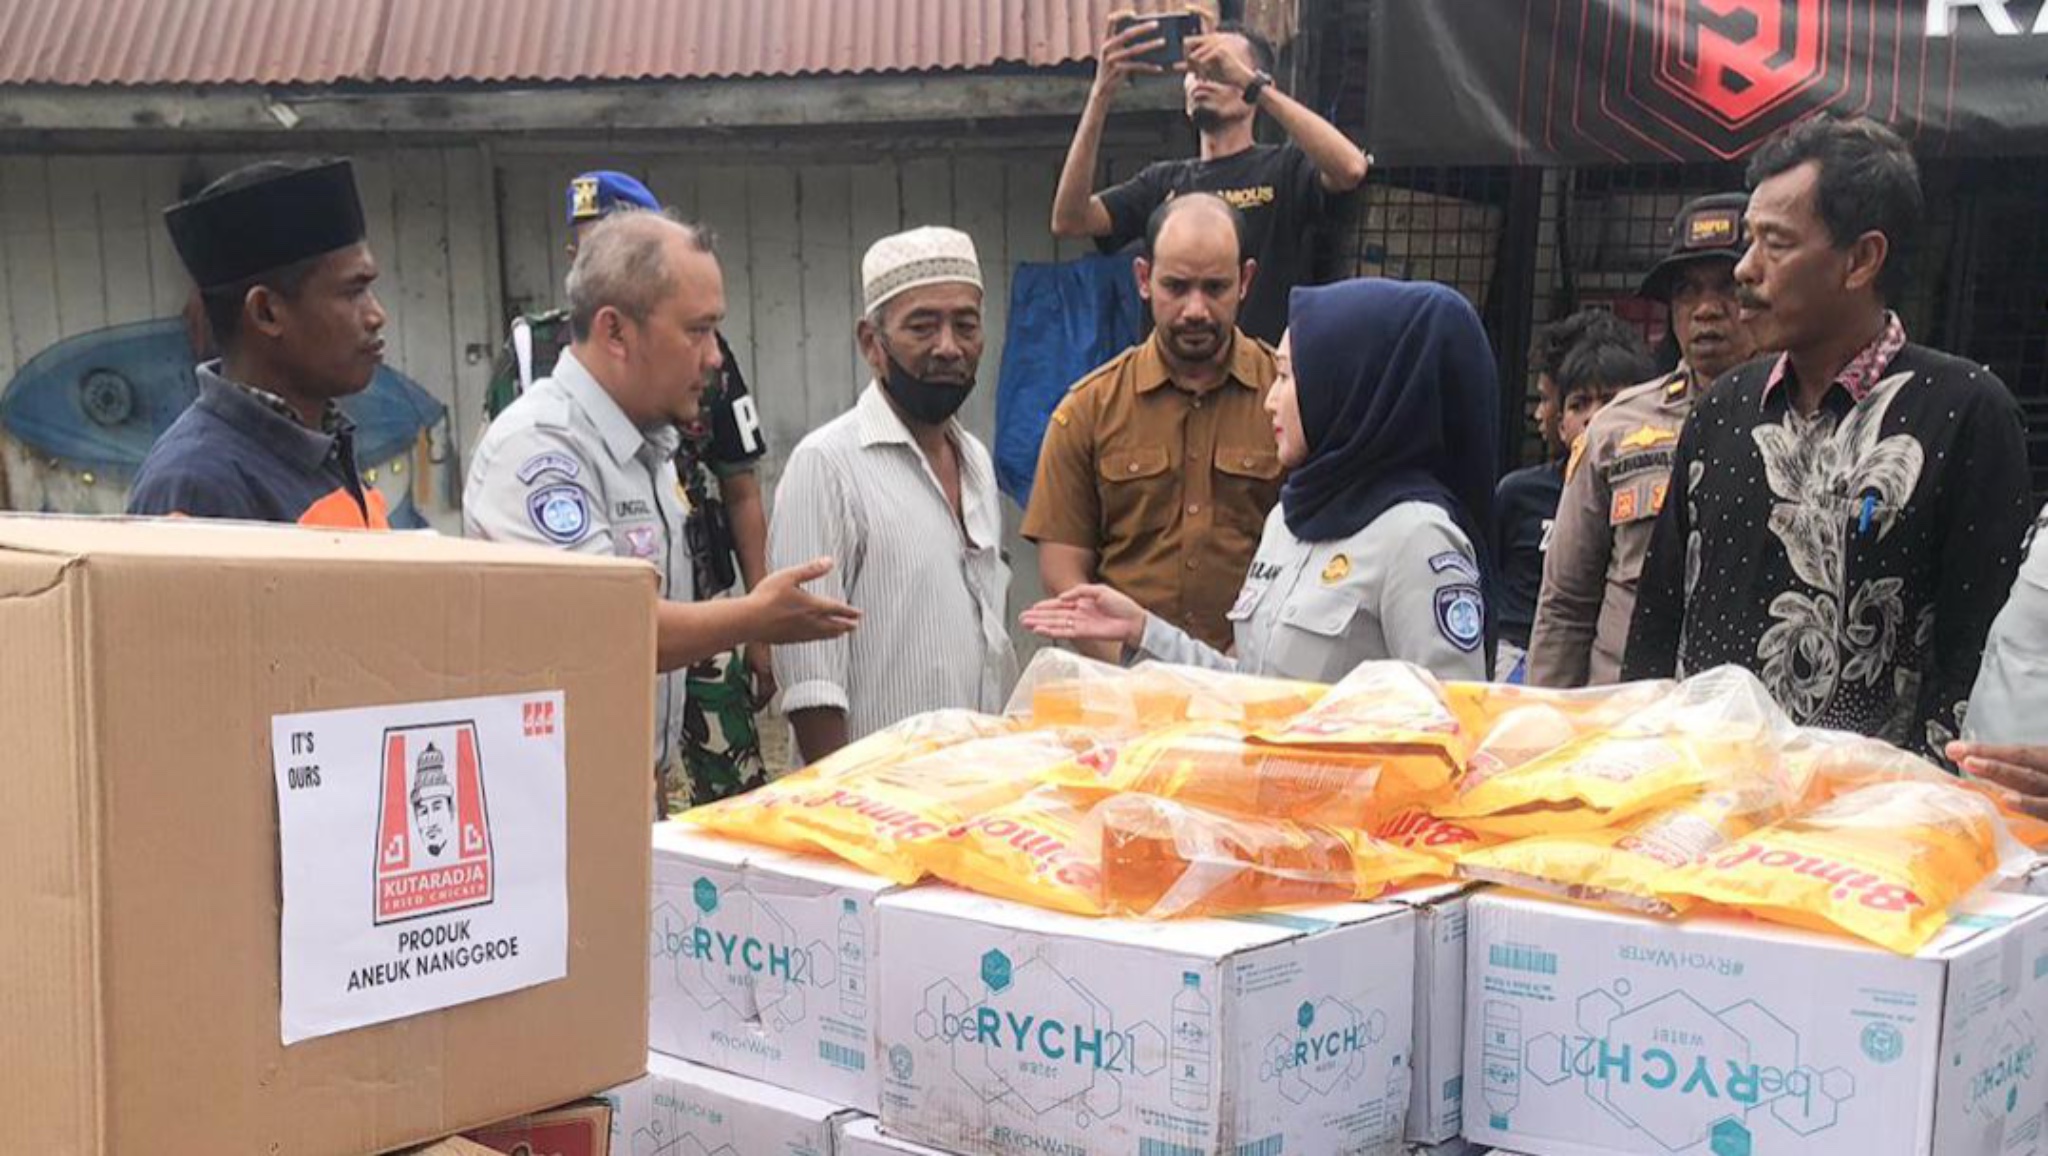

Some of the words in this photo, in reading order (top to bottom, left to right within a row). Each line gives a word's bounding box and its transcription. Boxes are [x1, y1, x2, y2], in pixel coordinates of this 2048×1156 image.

[291, 731, 315, 754] IT'S
[288, 765, 322, 790] OURS
[790, 791, 943, 840] Bimol
[384, 864, 485, 899] KUTARADJA
[1696, 844, 1925, 912] Bimol
[398, 920, 471, 953] PRODUK
[347, 958, 412, 992] ANEUK
[416, 936, 520, 977] NANGGROE
